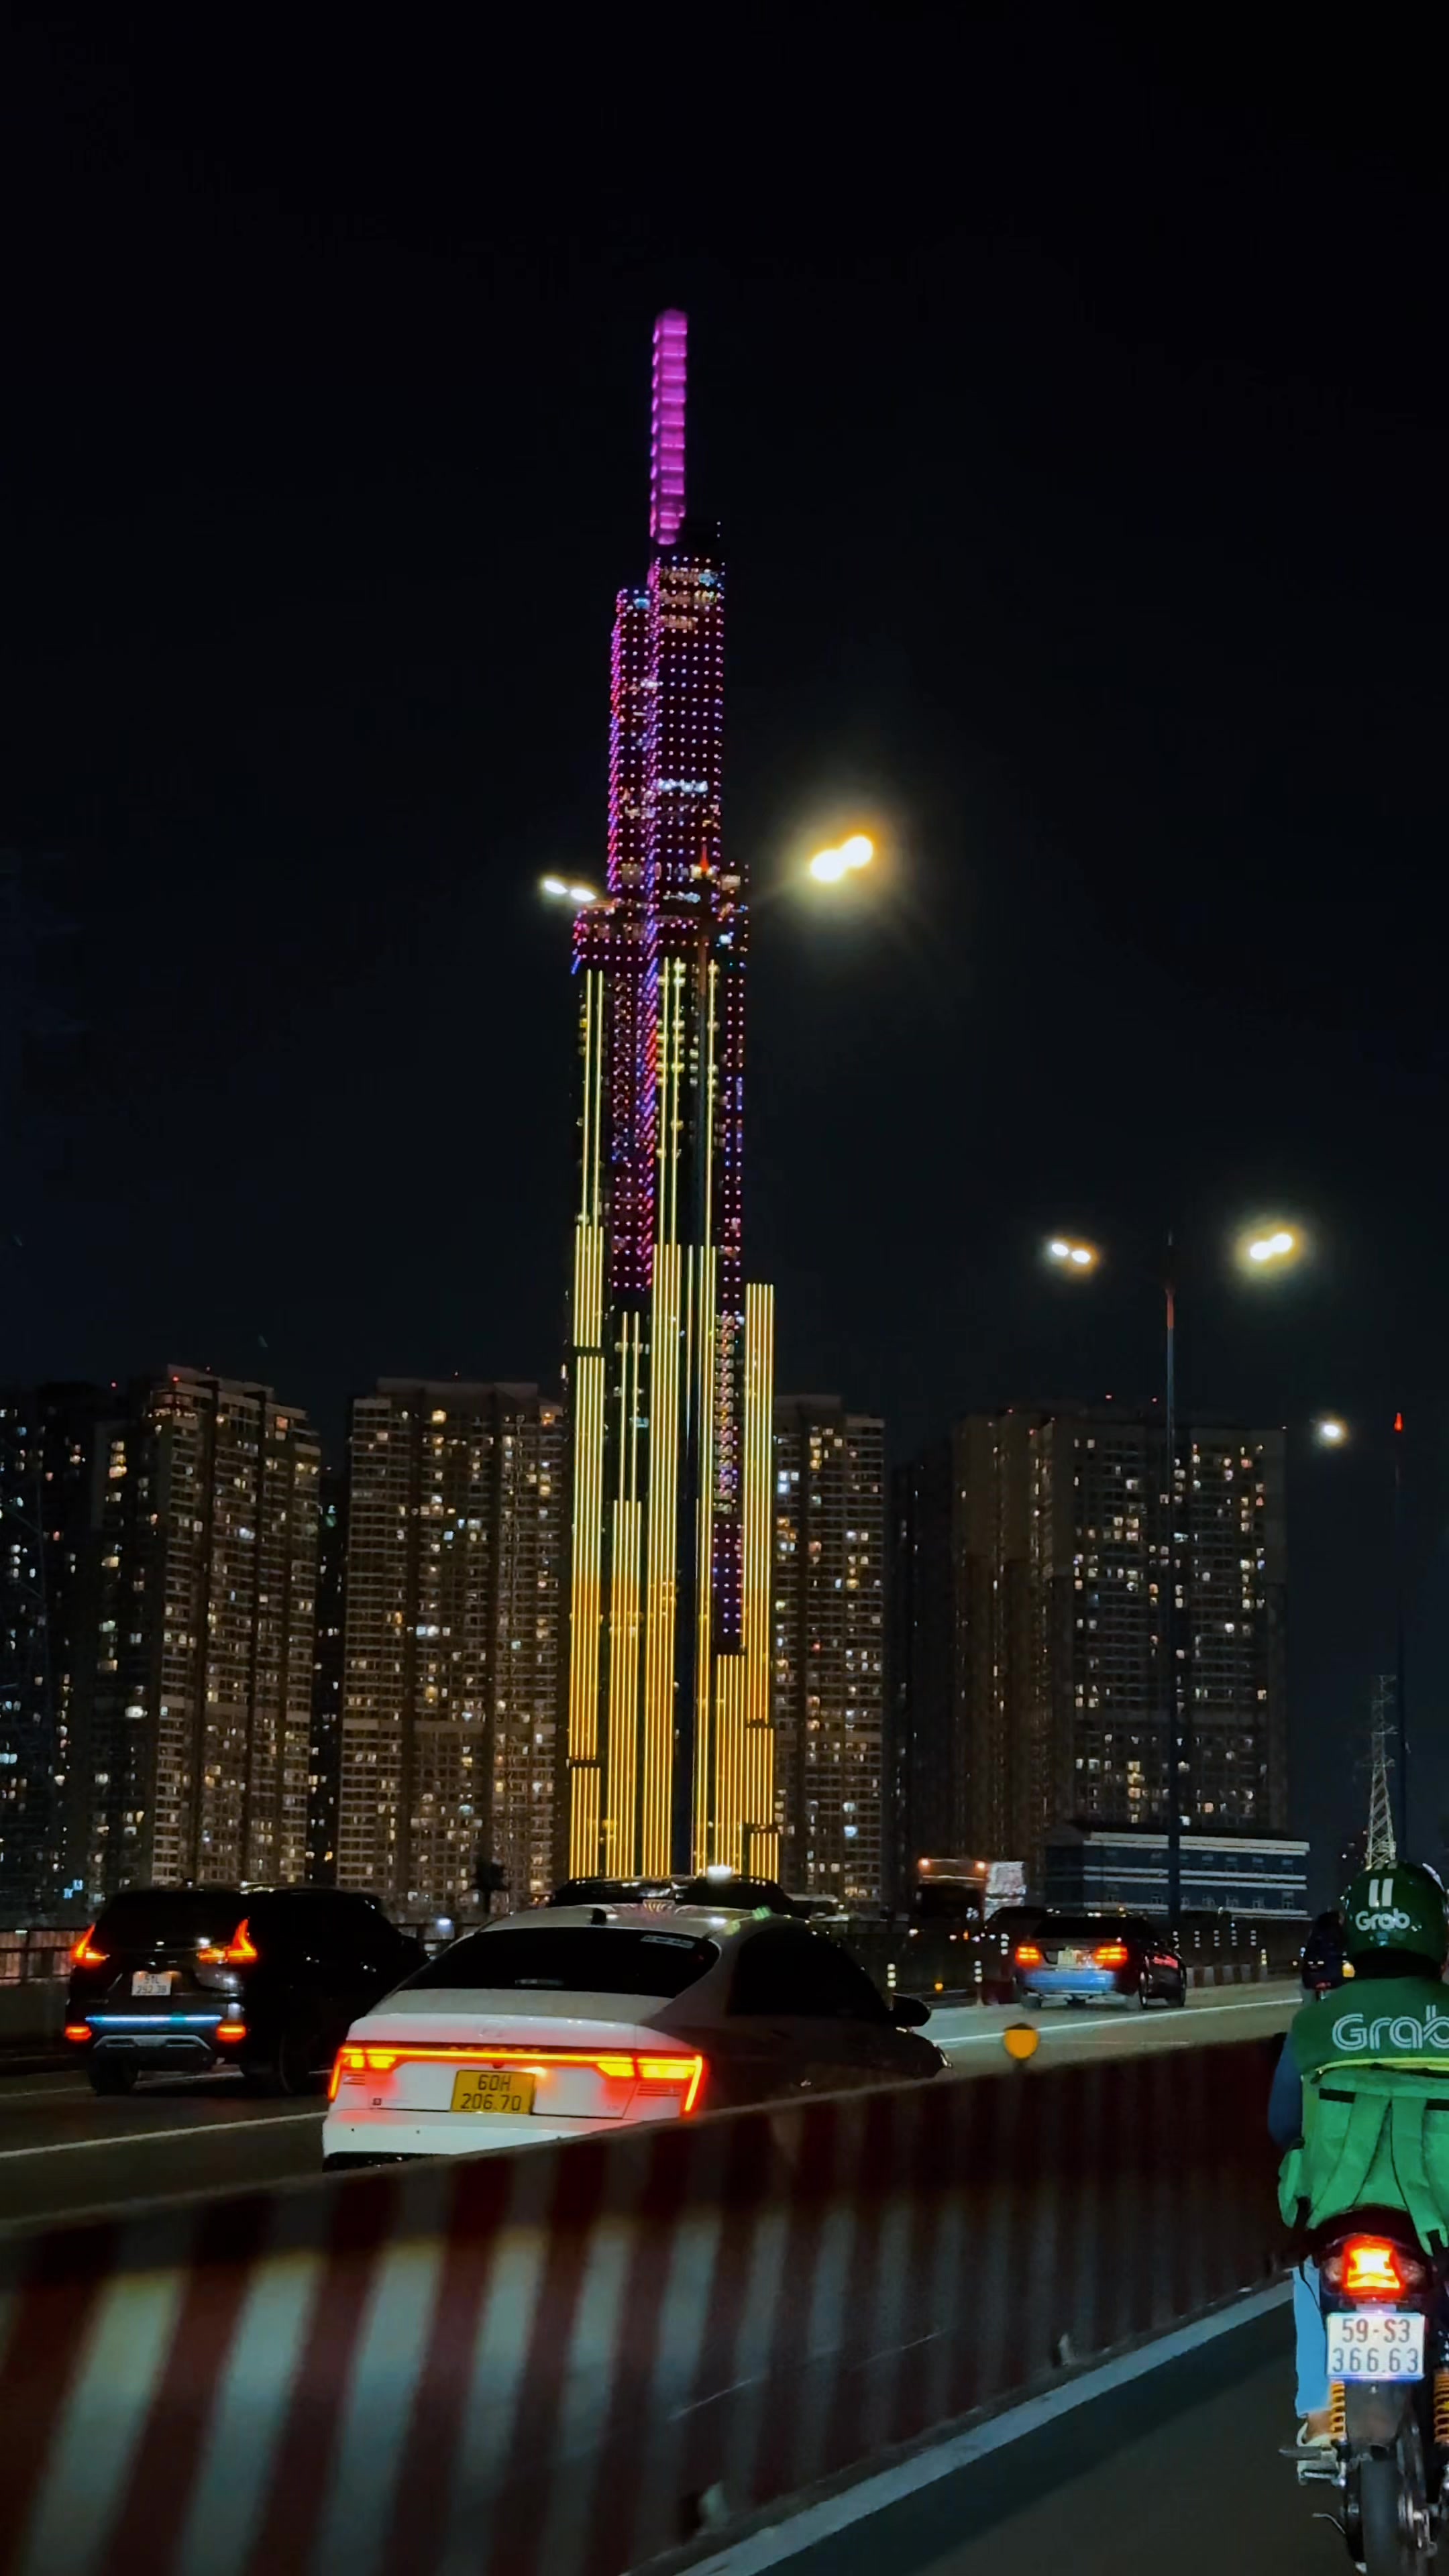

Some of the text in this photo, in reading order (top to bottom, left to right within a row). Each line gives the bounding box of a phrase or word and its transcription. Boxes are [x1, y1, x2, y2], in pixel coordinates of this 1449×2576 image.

[1355, 1909, 1410, 1931] Grab
[1332, 2005, 1449, 2051] Grab
[478, 2074, 511, 2091] 60H
[1342, 2318, 1410, 2343] 59-S3
[1332, 2348, 1418, 2373] 366.63
